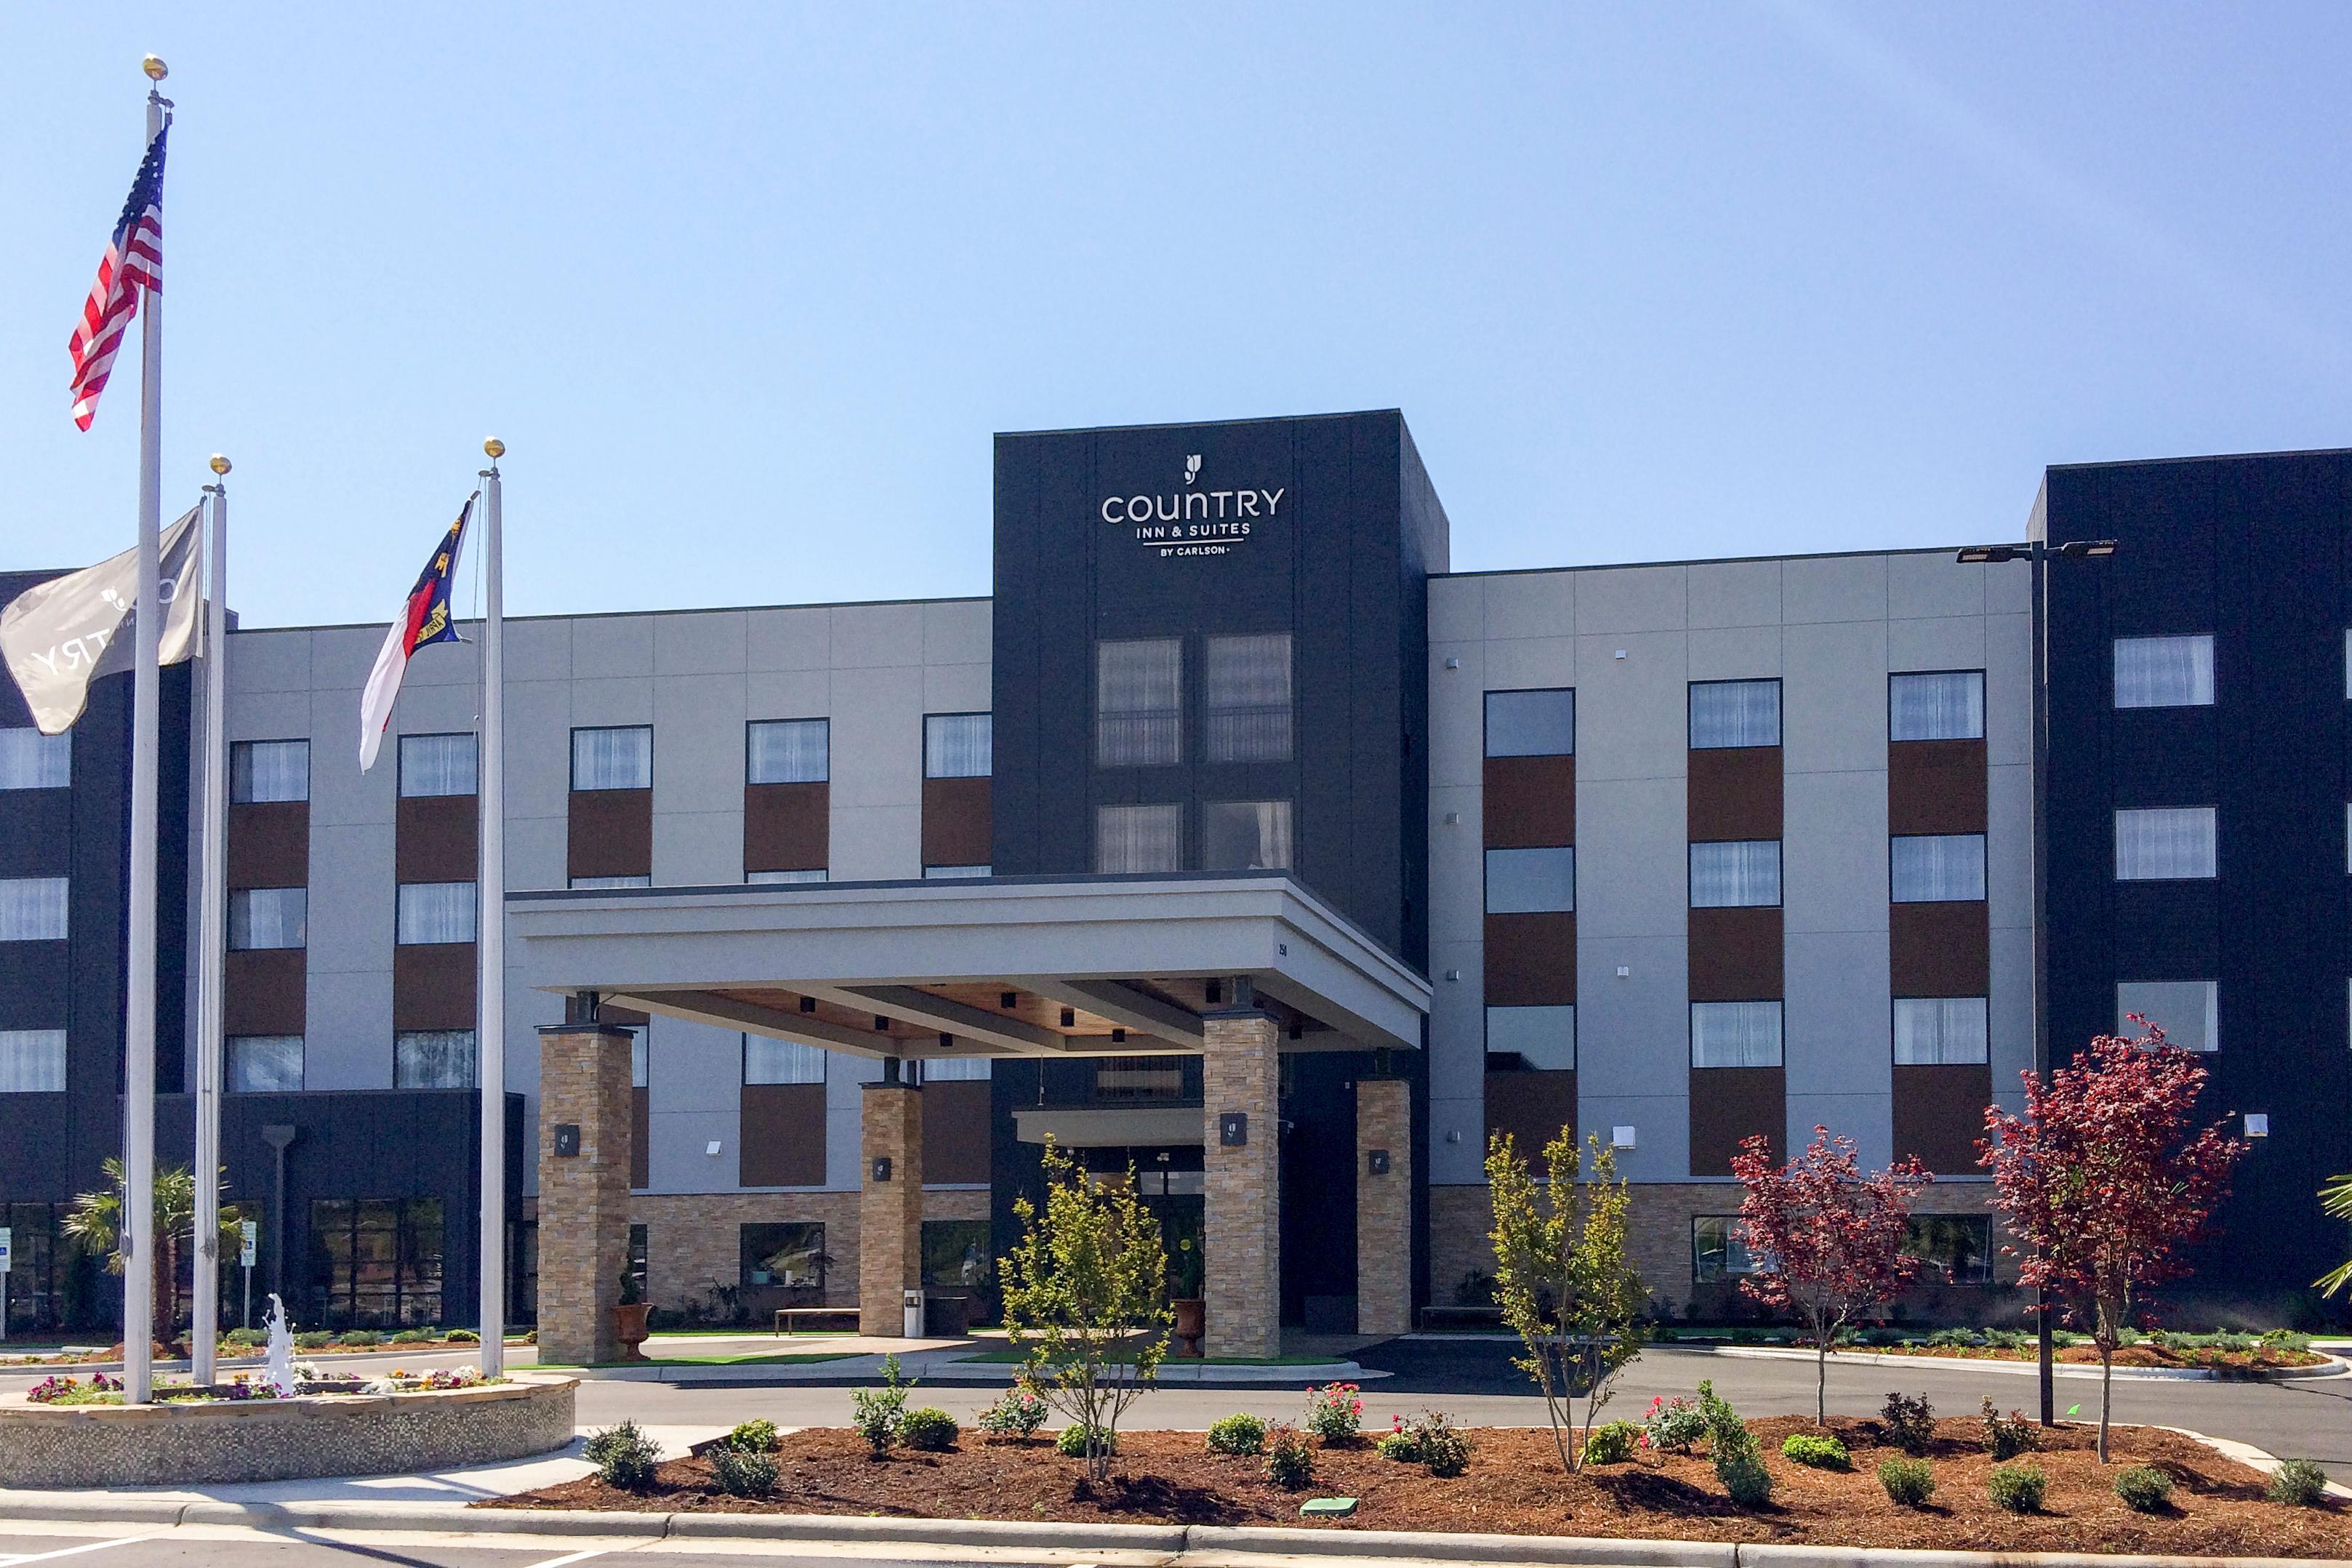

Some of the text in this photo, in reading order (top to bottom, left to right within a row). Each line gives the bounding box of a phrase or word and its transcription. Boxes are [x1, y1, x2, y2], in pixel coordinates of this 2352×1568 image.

[1136, 523, 1251, 539] INN & SUITES
[1160, 546, 1226, 557] BY CARLSON
